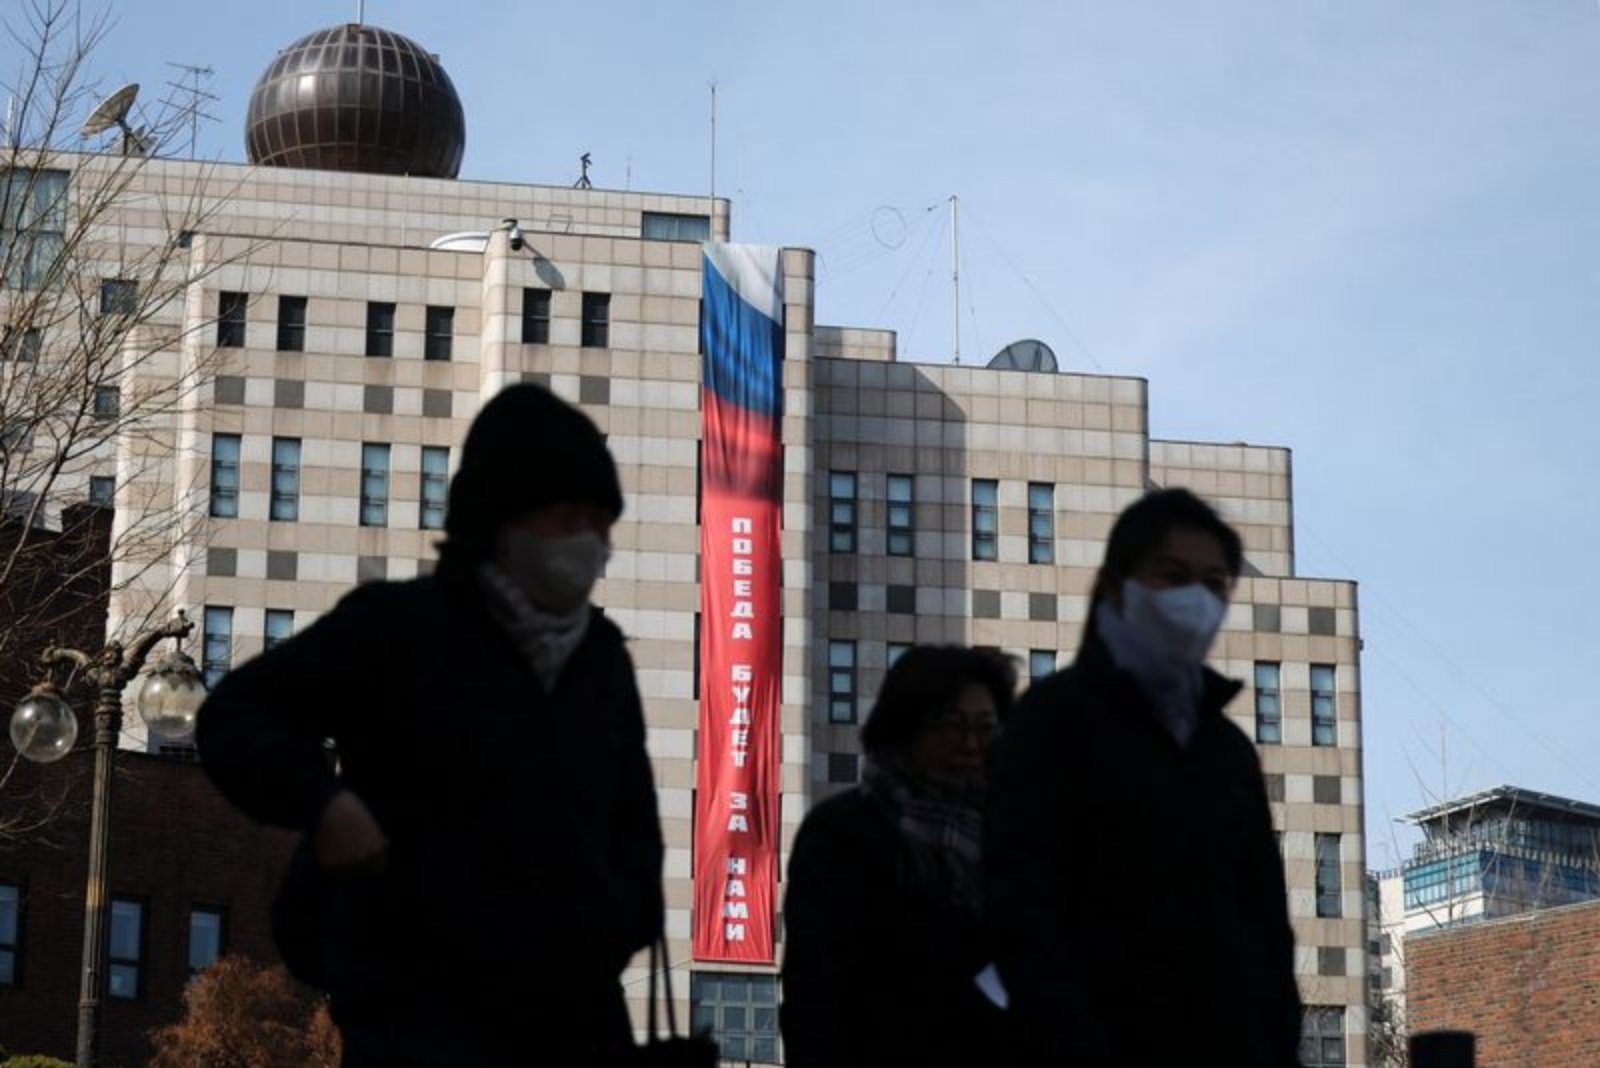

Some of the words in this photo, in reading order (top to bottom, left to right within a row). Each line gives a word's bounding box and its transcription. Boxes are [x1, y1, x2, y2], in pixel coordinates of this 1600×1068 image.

[731, 517, 753, 639] ПОБЕДА
[729, 664, 752, 768] БУДЕТ
[728, 792, 748, 832] ЗА
[724, 858, 748, 941] НАМИ
